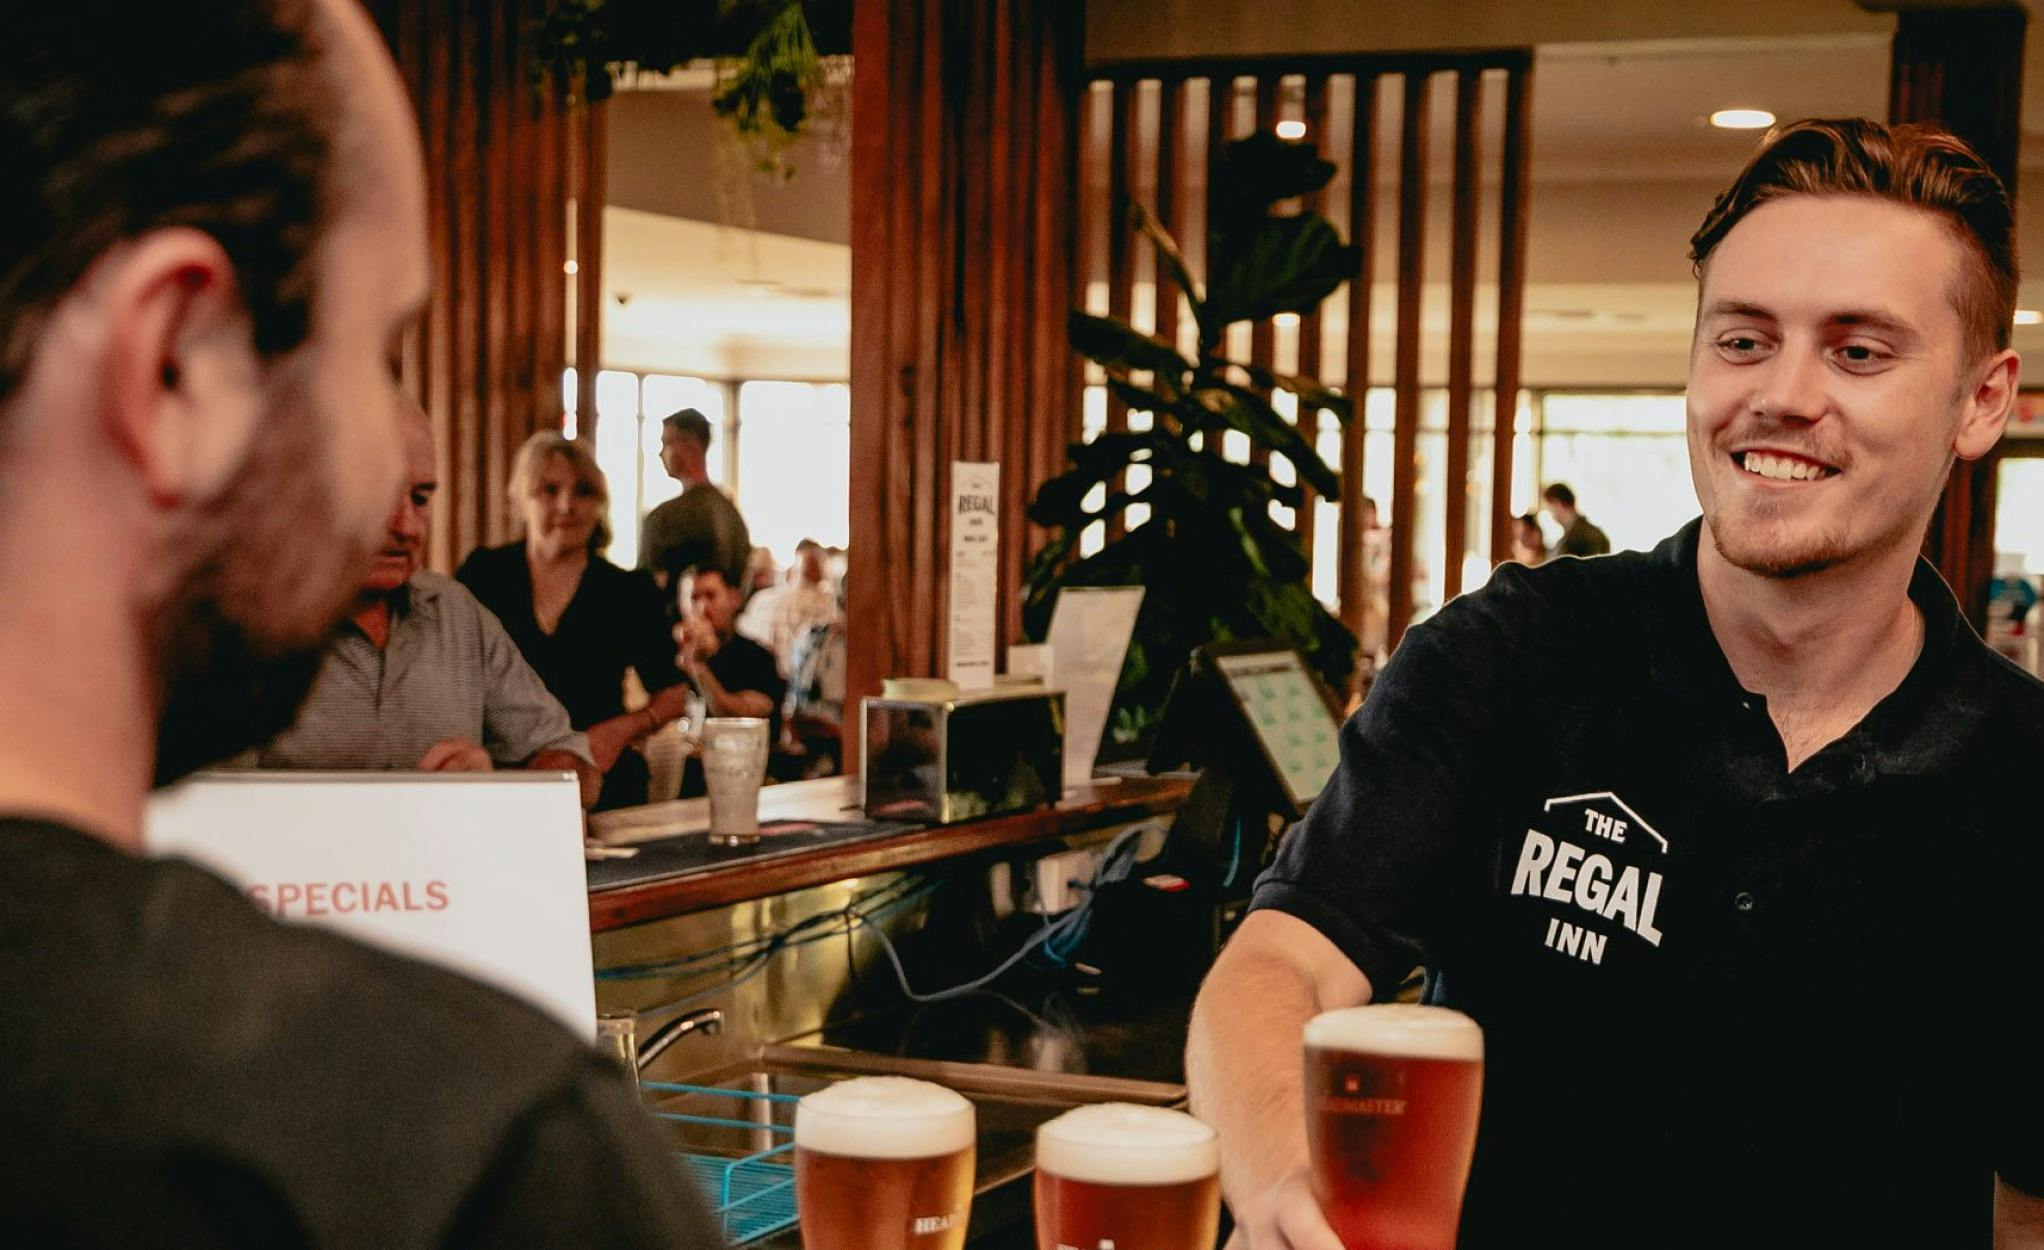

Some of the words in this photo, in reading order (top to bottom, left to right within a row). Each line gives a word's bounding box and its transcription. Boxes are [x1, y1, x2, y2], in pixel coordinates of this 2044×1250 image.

[959, 494, 996, 515] REGAL
[1584, 808, 1628, 844] THE
[249, 879, 449, 917] SPECIALS
[1511, 828, 1663, 947] REGAL
[1544, 917, 1608, 965] INN
